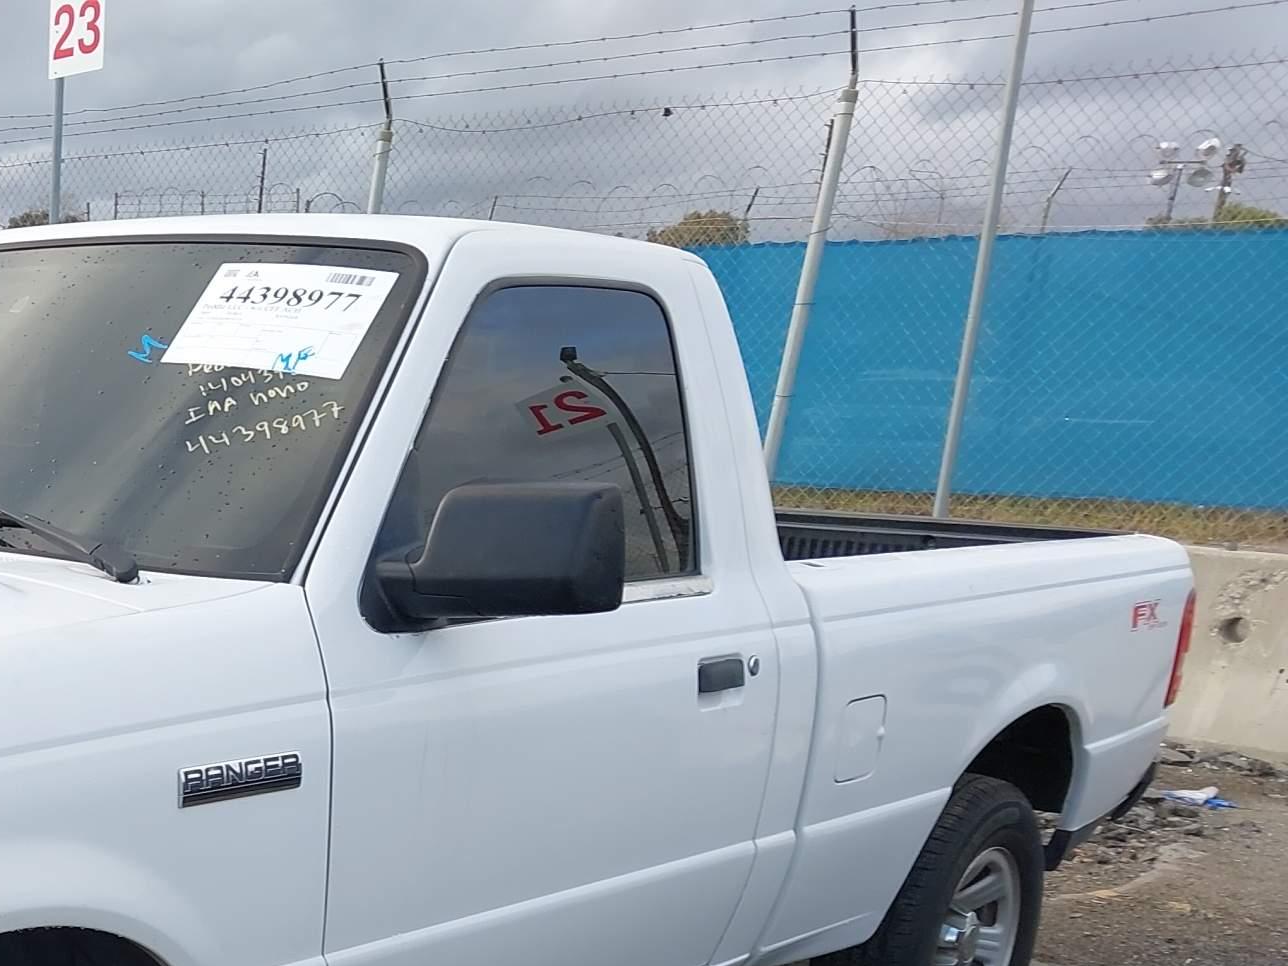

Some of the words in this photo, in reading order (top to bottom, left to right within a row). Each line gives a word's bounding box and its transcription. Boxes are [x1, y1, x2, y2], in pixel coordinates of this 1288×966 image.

[53, 0, 100, 60] 23
[219, 286, 363, 312] 44398977
[185, 401, 344, 454] 44398977
[183, 753, 302, 793] RANGER
